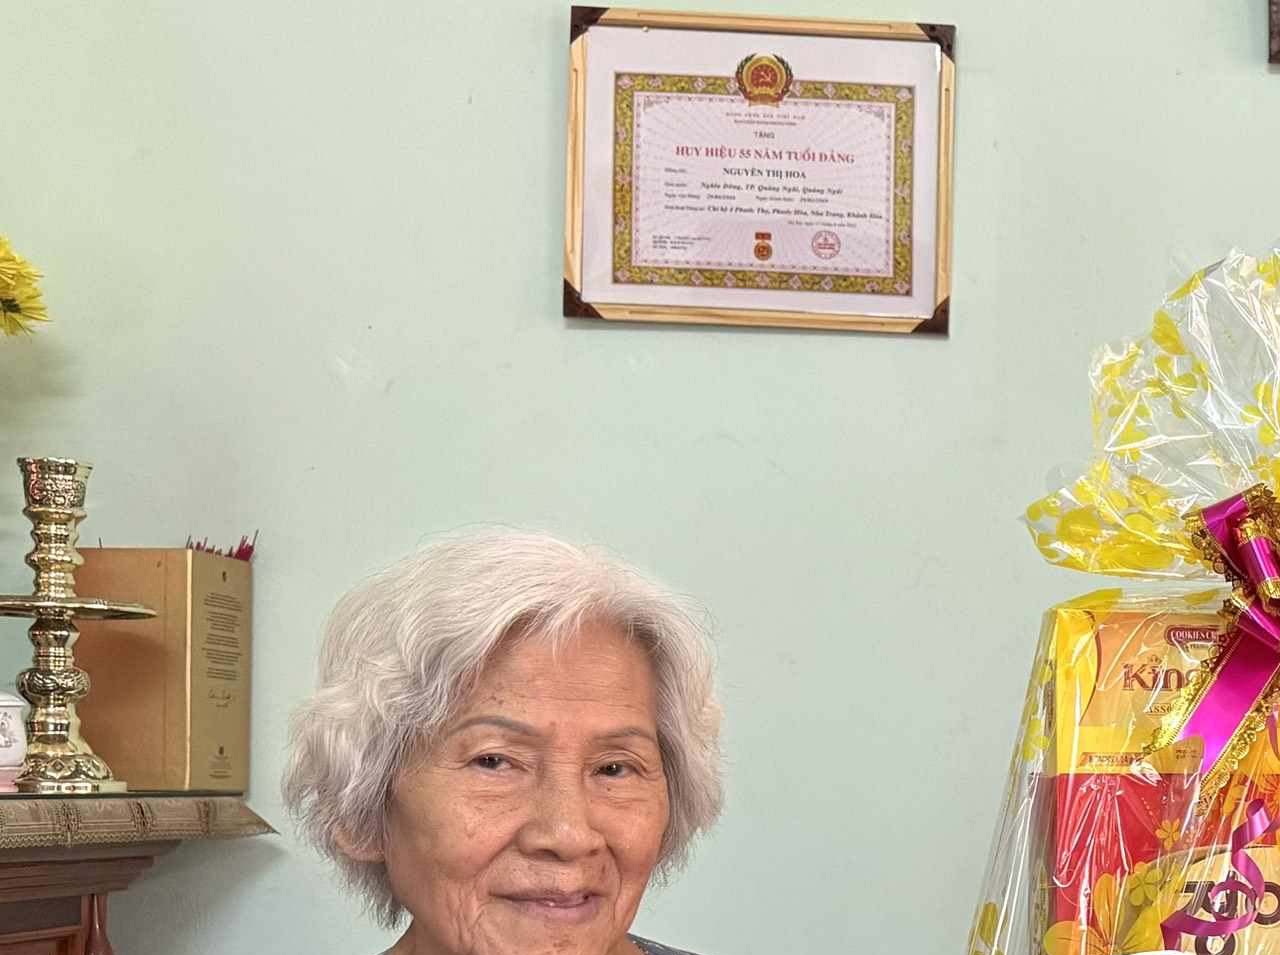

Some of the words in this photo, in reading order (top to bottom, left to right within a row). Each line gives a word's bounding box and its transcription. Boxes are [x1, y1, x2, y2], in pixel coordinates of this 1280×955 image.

[676, 146, 701, 156] HUY
[705, 147, 736, 159] HIỆU
[739, 149, 751, 158] 55
[765, 170, 782, 179] THỊ
[786, 171, 806, 179] HOA
[1170, 629, 1206, 640] COOKIES
